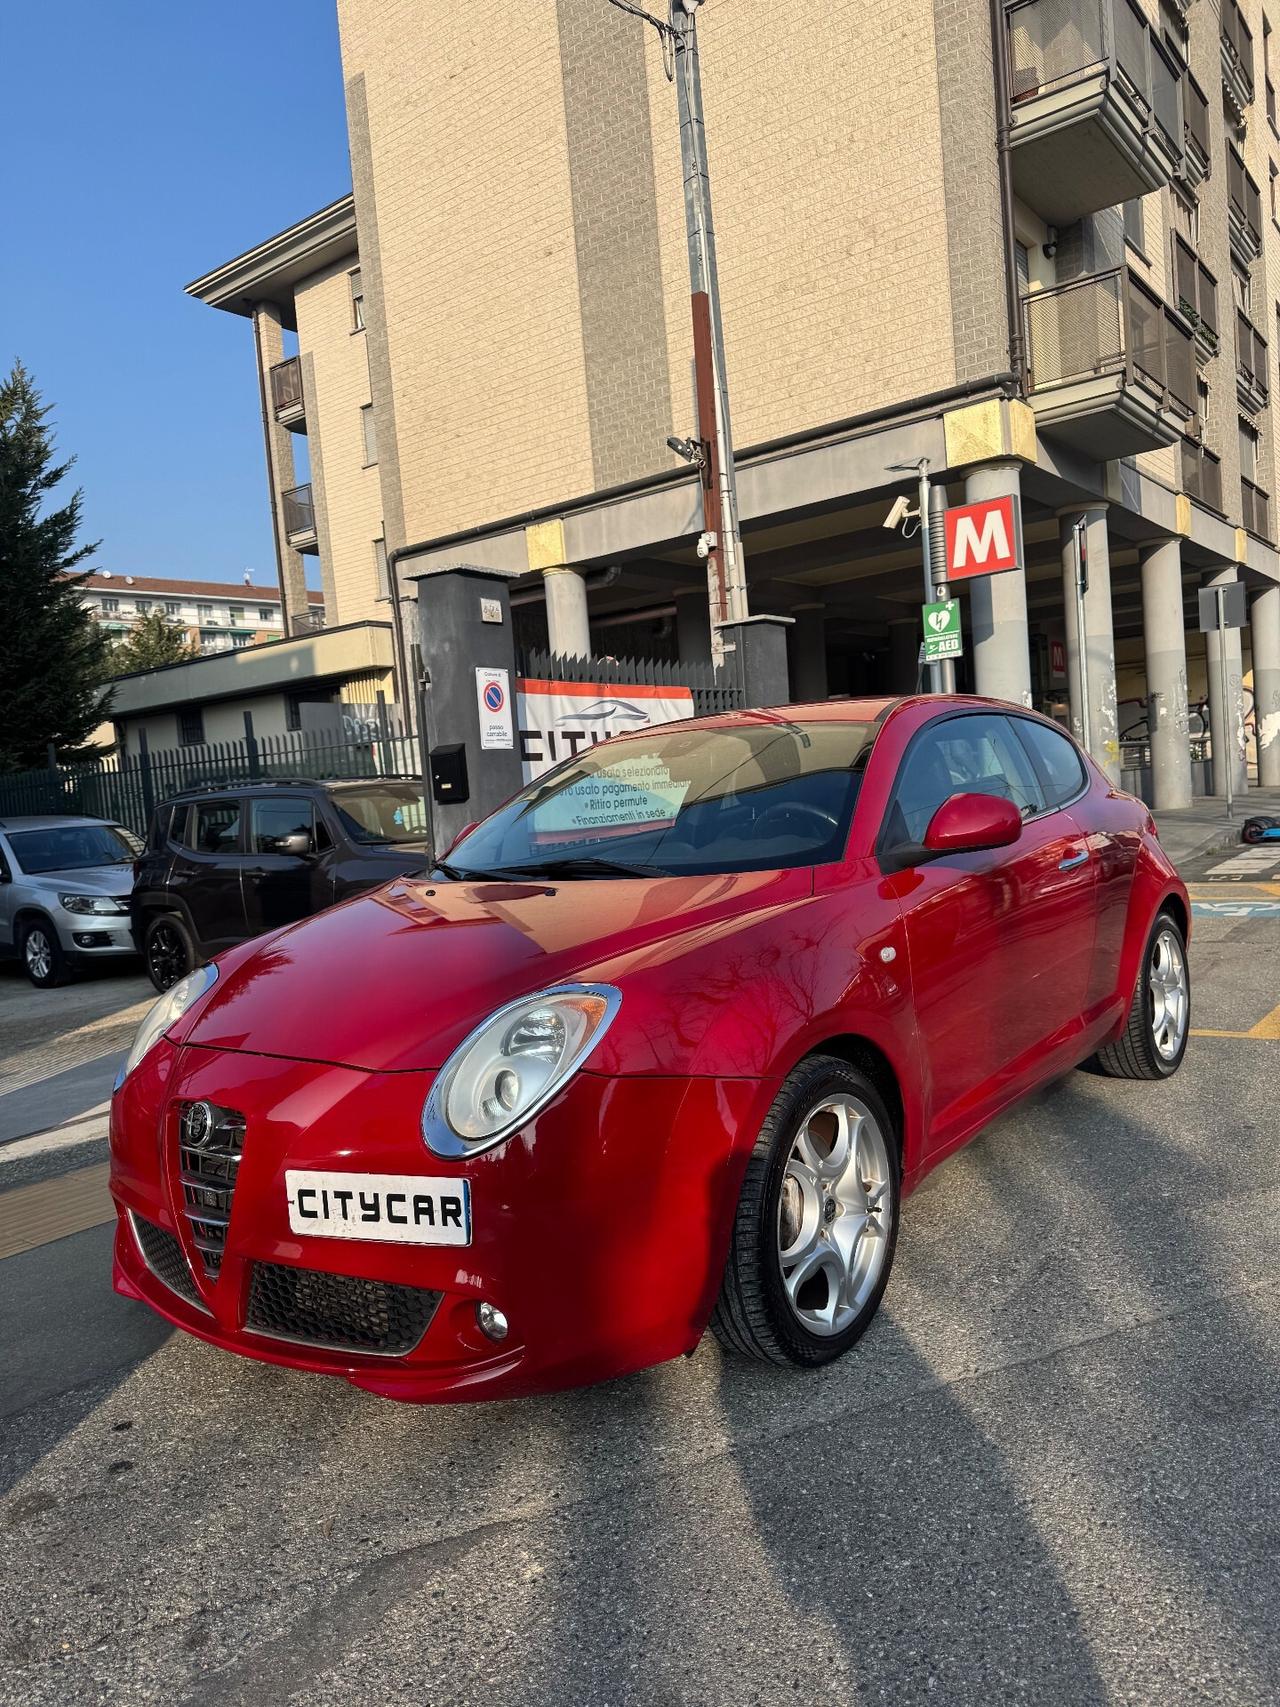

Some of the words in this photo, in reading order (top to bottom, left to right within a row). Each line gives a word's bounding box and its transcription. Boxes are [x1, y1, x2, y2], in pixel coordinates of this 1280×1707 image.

[953, 509, 1010, 568] M
[939, 639, 958, 652] AED
[1053, 646, 1063, 666] M
[597, 767, 620, 778] usato
[622, 766, 669, 777] selezionato
[575, 784, 600, 795] usato
[602, 781, 650, 796] pagamento
[590, 799, 611, 810] Ritiro
[614, 796, 648, 810] permute
[575, 811, 634, 825] Finanziamenti
[636, 811, 645, 819] in
[645, 808, 666, 818] sede
[298, 1189, 462, 1227] CITYCAR
